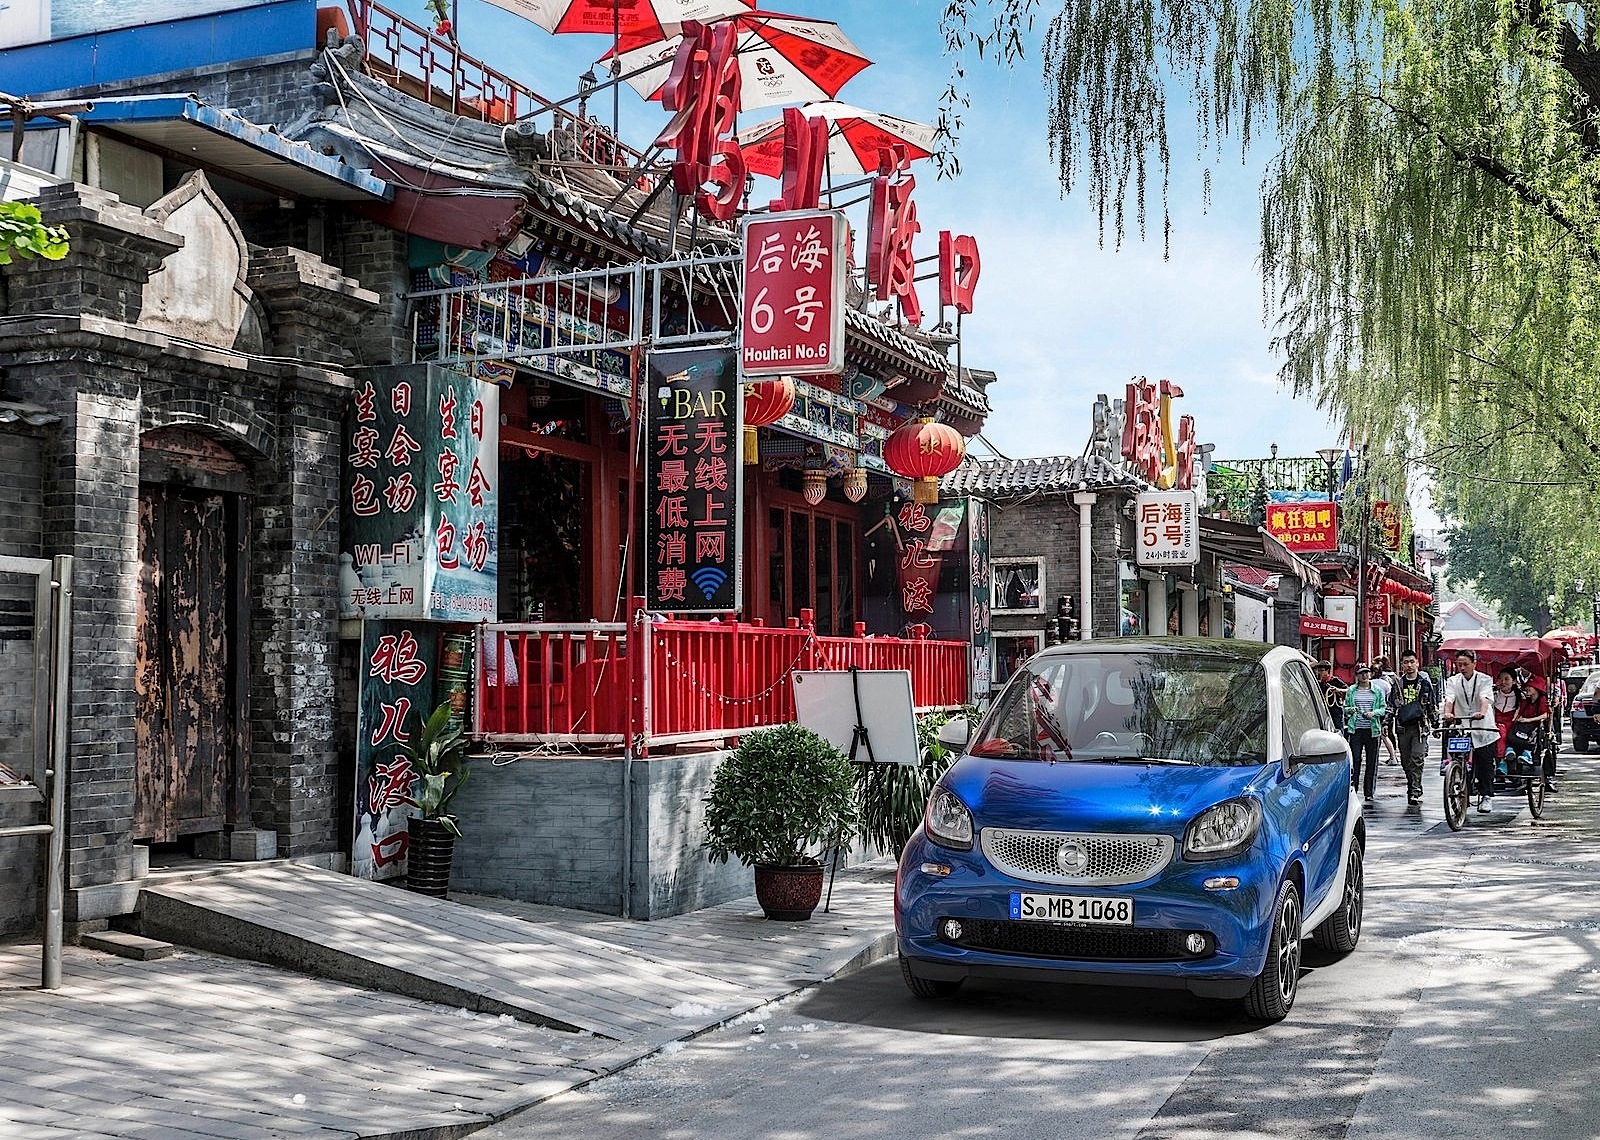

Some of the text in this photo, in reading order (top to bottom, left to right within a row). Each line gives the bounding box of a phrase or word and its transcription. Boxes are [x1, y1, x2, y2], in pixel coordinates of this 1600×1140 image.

[750, 224, 829, 275] 后海
[750, 285, 824, 334] 6号
[744, 342, 827, 362] Houhai No.6
[673, 388, 728, 419] BAR
[693, 421, 728, 564] 无线上网
[656, 423, 689, 602] 无最低消费
[1140, 502, 1183, 523] 后海
[1143, 525, 1184, 546] 5号
[1277, 532, 1326, 544] BBQ BAR
[354, 543, 411, 567] WI-FI
[1145, 550, 1188, 559] 24小时营业
[350, 587, 414, 606] 无线上网
[1022, 896, 1035, 916] S
[1078, 900, 1129, 921] 1068
